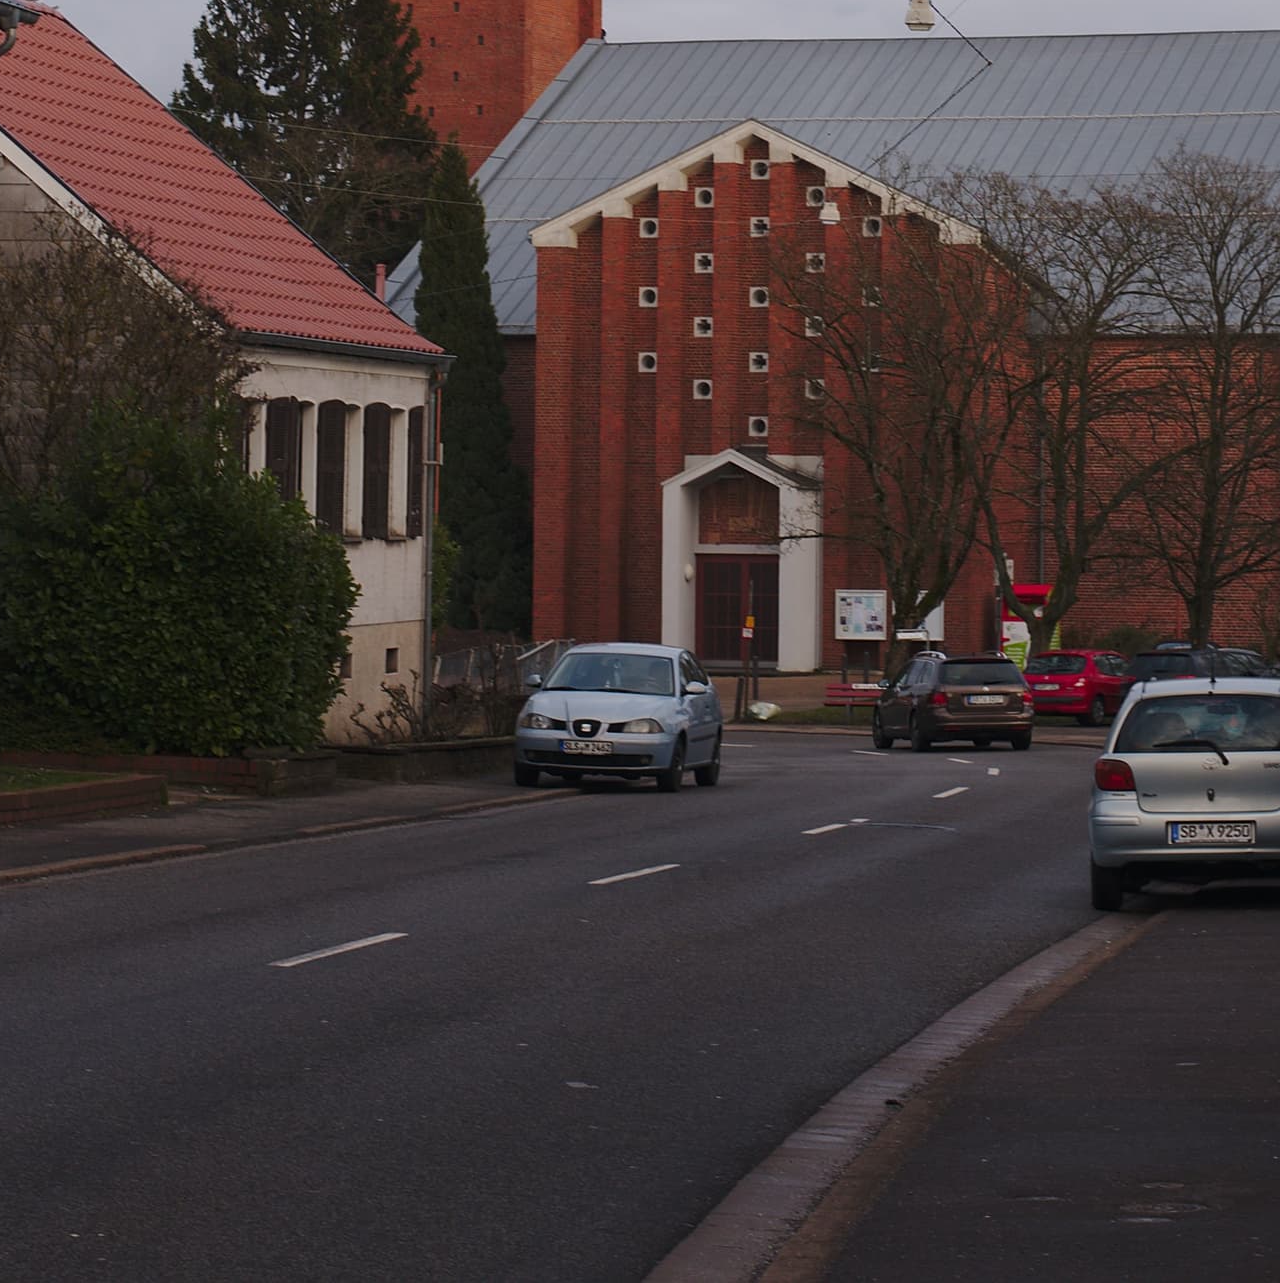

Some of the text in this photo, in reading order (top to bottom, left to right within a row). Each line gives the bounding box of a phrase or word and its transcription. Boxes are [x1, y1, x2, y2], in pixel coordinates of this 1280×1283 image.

[1180, 825, 1250, 838] SB X 9250
